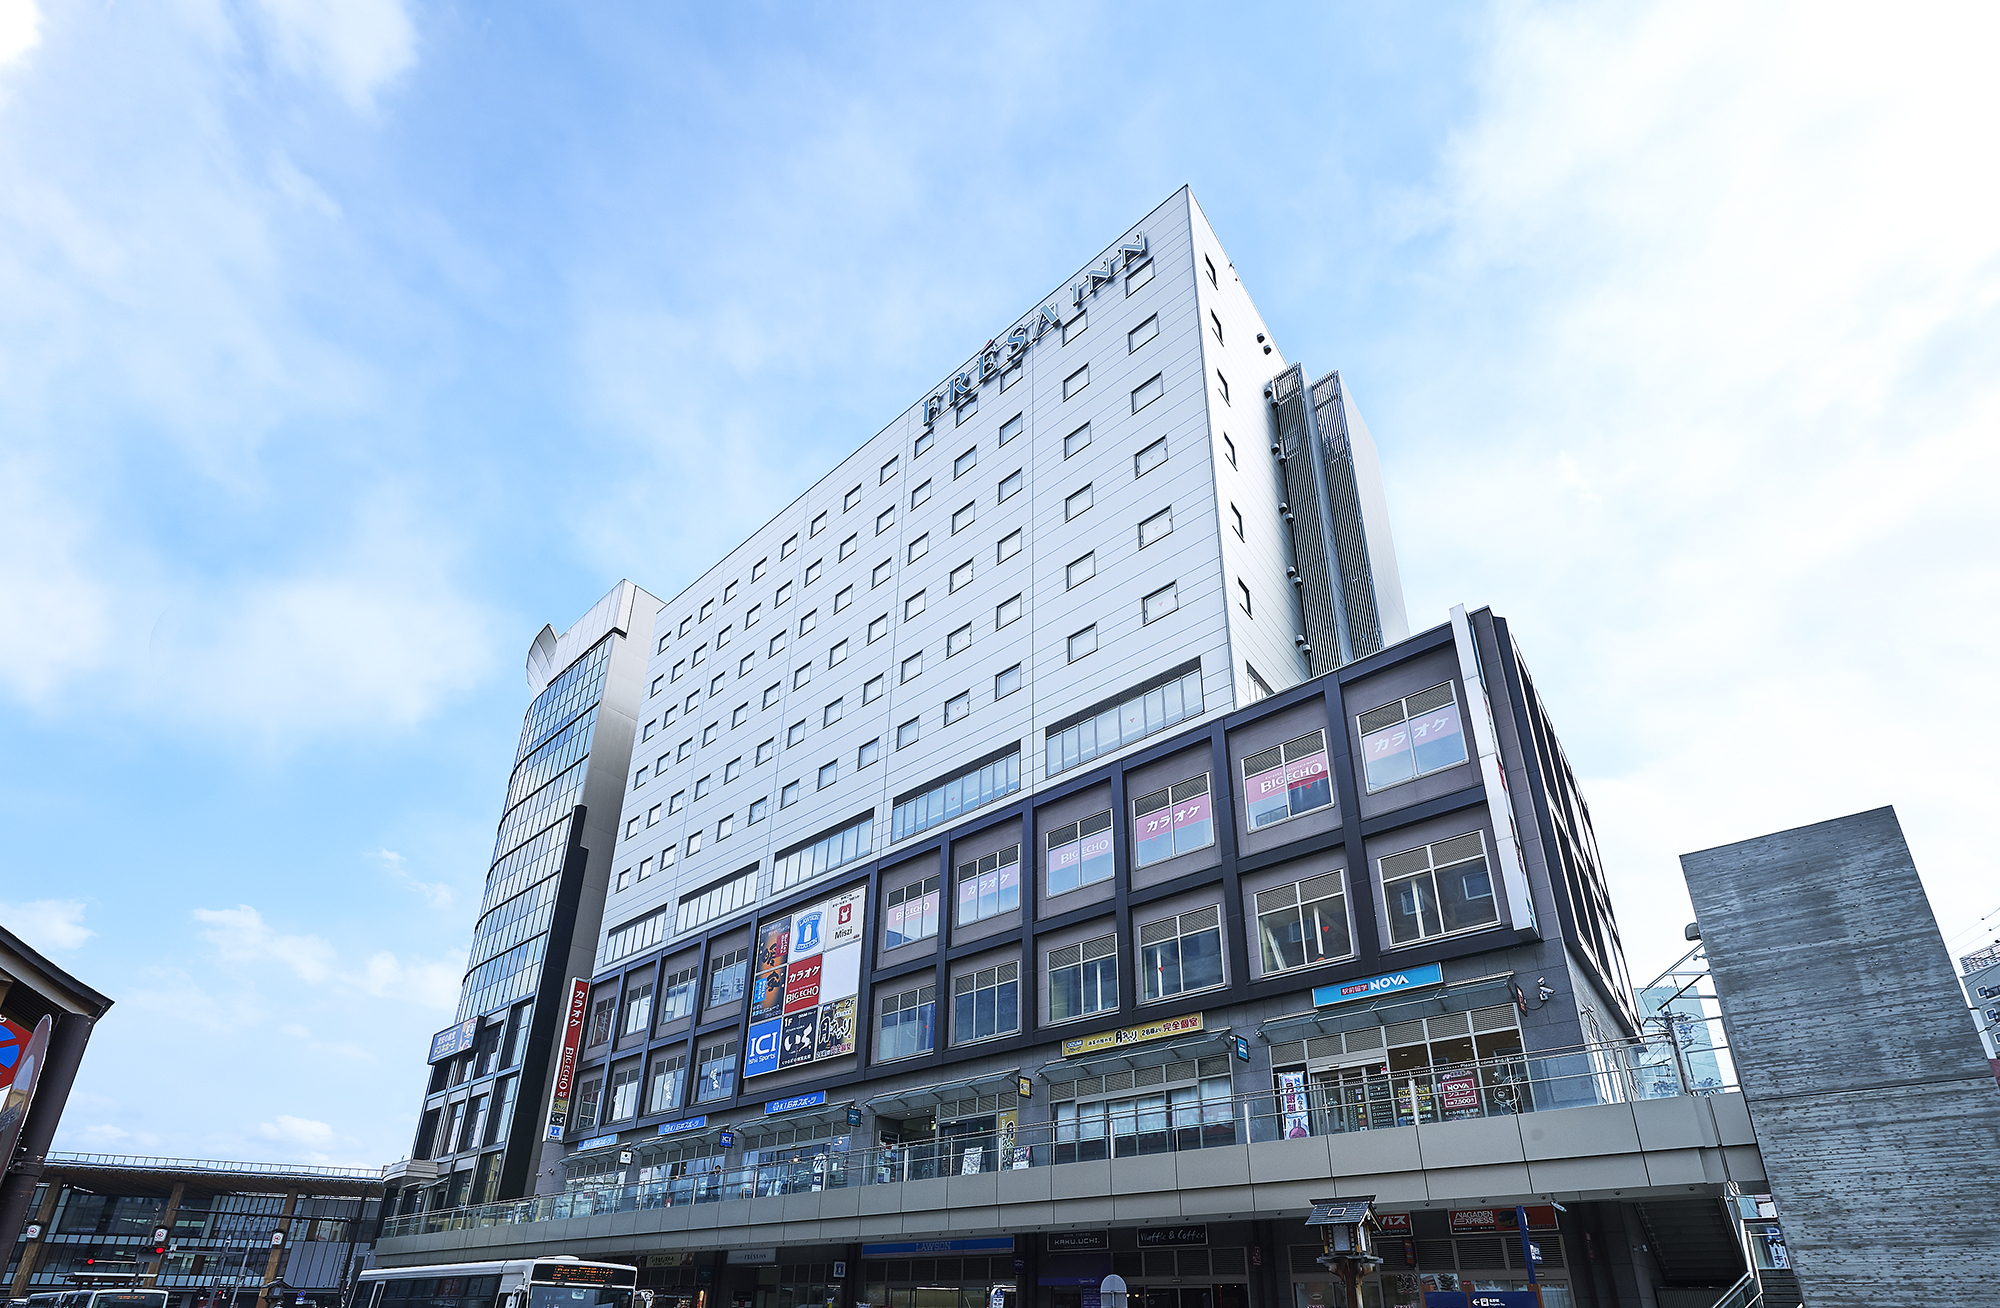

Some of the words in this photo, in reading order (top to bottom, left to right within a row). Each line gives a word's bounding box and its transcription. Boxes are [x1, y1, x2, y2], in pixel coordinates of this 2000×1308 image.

[922, 302, 1061, 427] FRÉSA
[1069, 229, 1147, 308] INN
[1374, 715, 1450, 754] カラオケ
[1261, 775, 1284, 794] BIG
[1286, 762, 1323, 781] ECHO
[1147, 803, 1201, 834] カラオケ
[1060, 849, 1079, 865] BIG
[1081, 839, 1109, 856] ECHO
[967, 872, 1010, 896] カラオケ
[799, 914, 821, 927] LAWSON
[797, 937, 819, 950] STATION
[788, 965, 821, 984] カラオケ
[1369, 974, 1409, 991] NOVA
[785, 991, 799, 1004] BIG
[800, 985, 819, 999] ECHO
[569, 989, 586, 1027] カラオケ
[845, 999, 855, 1009] 2F
[784, 1017, 793, 1028] 1F
[1163, 1017, 1198, 1033] 完全個室
[750, 1031, 778, 1058] ICI
[564, 1046, 574, 1064] BIG
[759, 1053, 776, 1063] Sports
[558, 1064, 571, 1090] ECHO
[1447, 1082, 1470, 1091] NOVA
[1453, 1217, 1494, 1225] EXPRESS
[1455, 1210, 1493, 1219] NAGADEN
[1140, 1231, 1167, 1243] Waffle
[1168, 1230, 1175, 1240] &
[1178, 1229, 1205, 1241] Coffee
[915, 1241, 951, 1252] LAWSON
